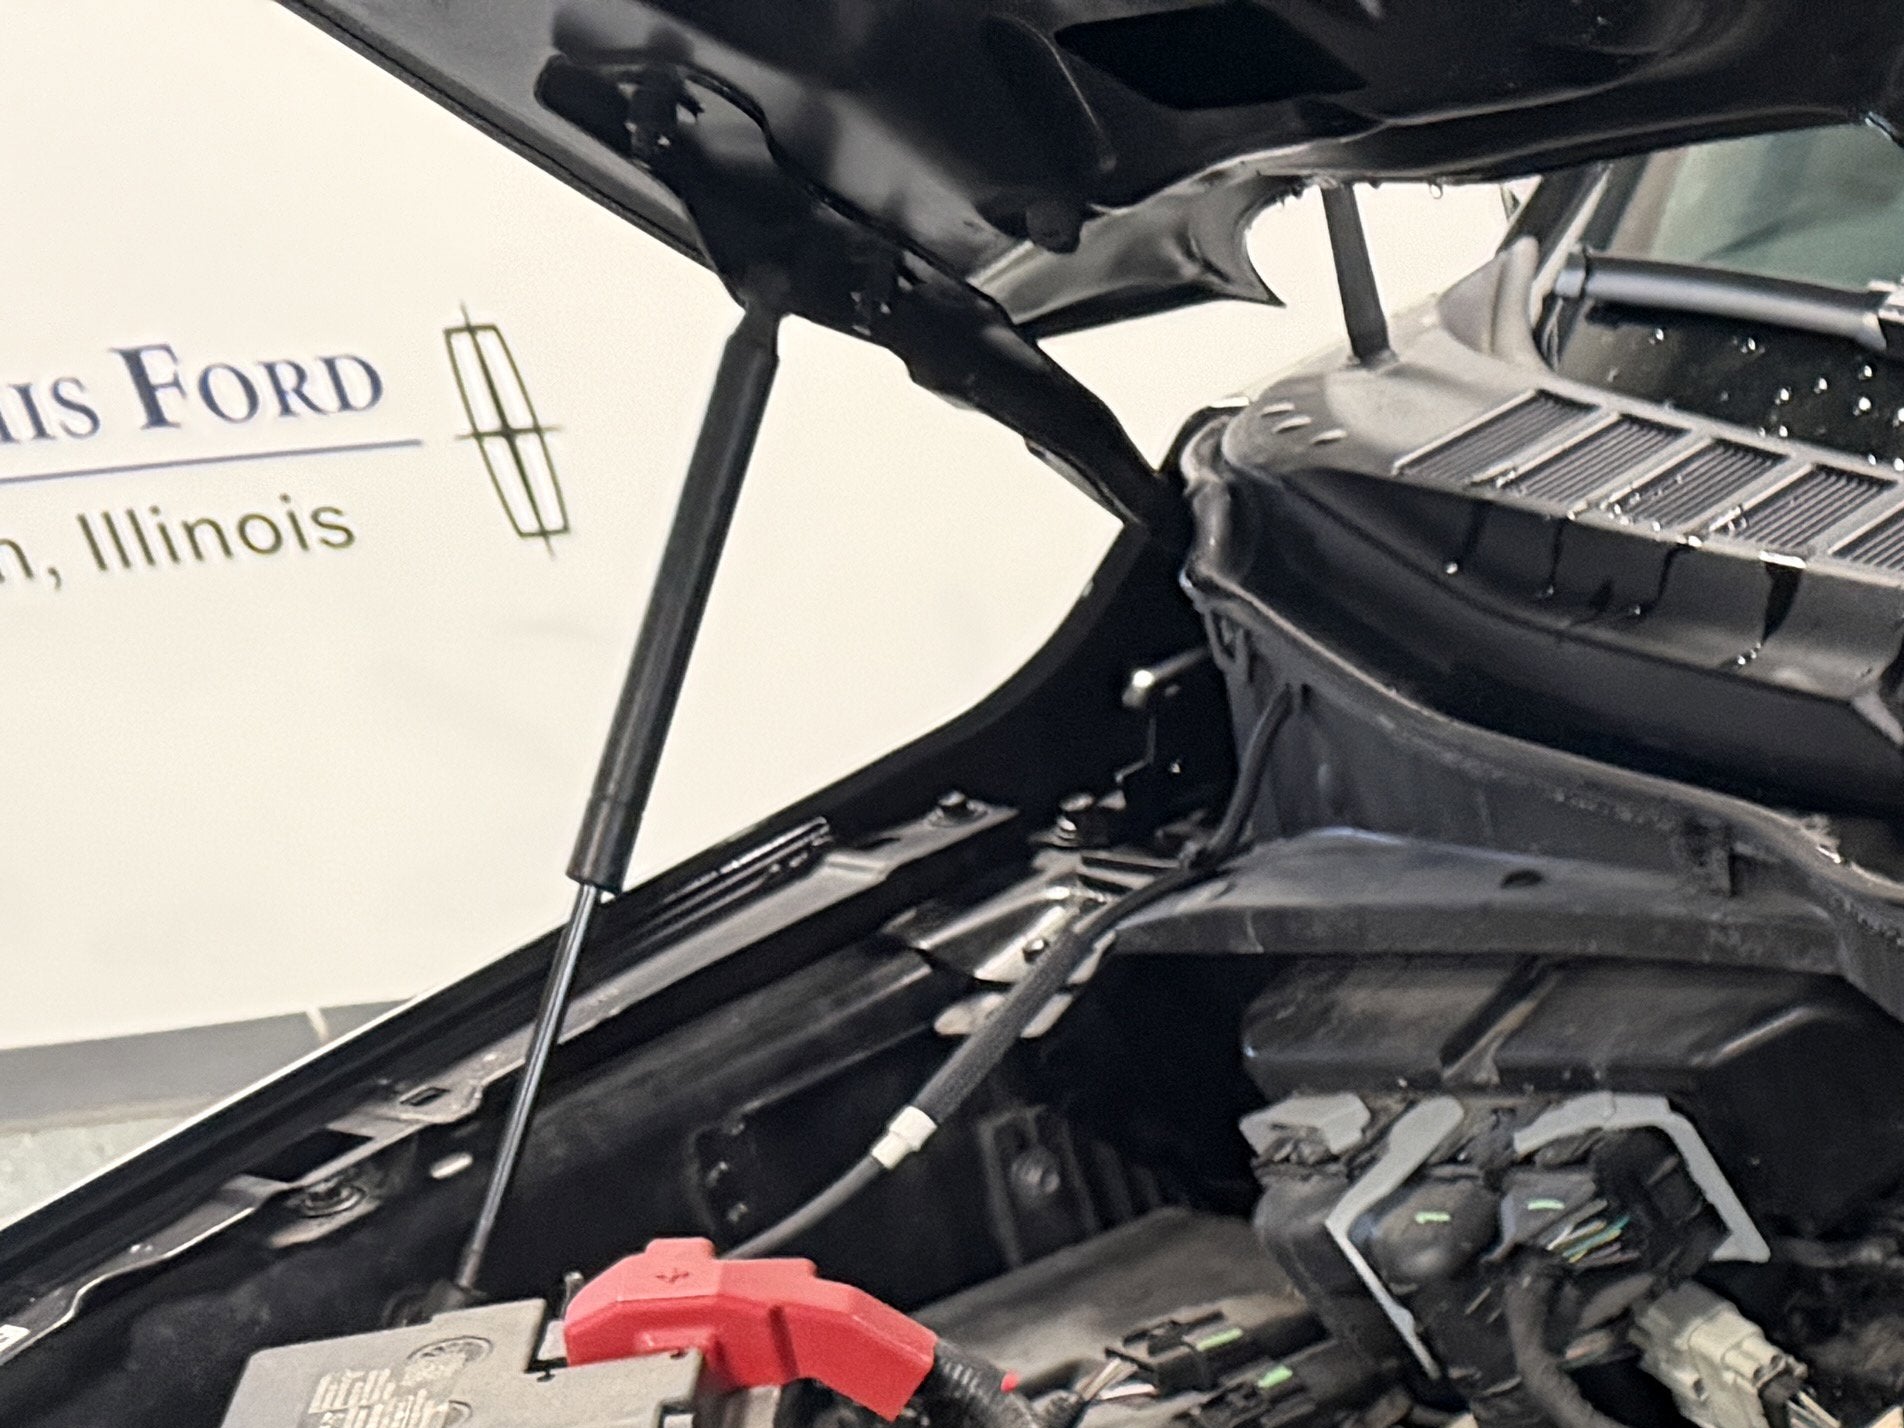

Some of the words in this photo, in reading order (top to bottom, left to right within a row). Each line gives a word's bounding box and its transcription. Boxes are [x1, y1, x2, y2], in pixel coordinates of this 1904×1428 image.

[0, 376, 100, 444] IS
[107, 343, 384, 430] FORD
[77, 492, 356, 571] Illinois
